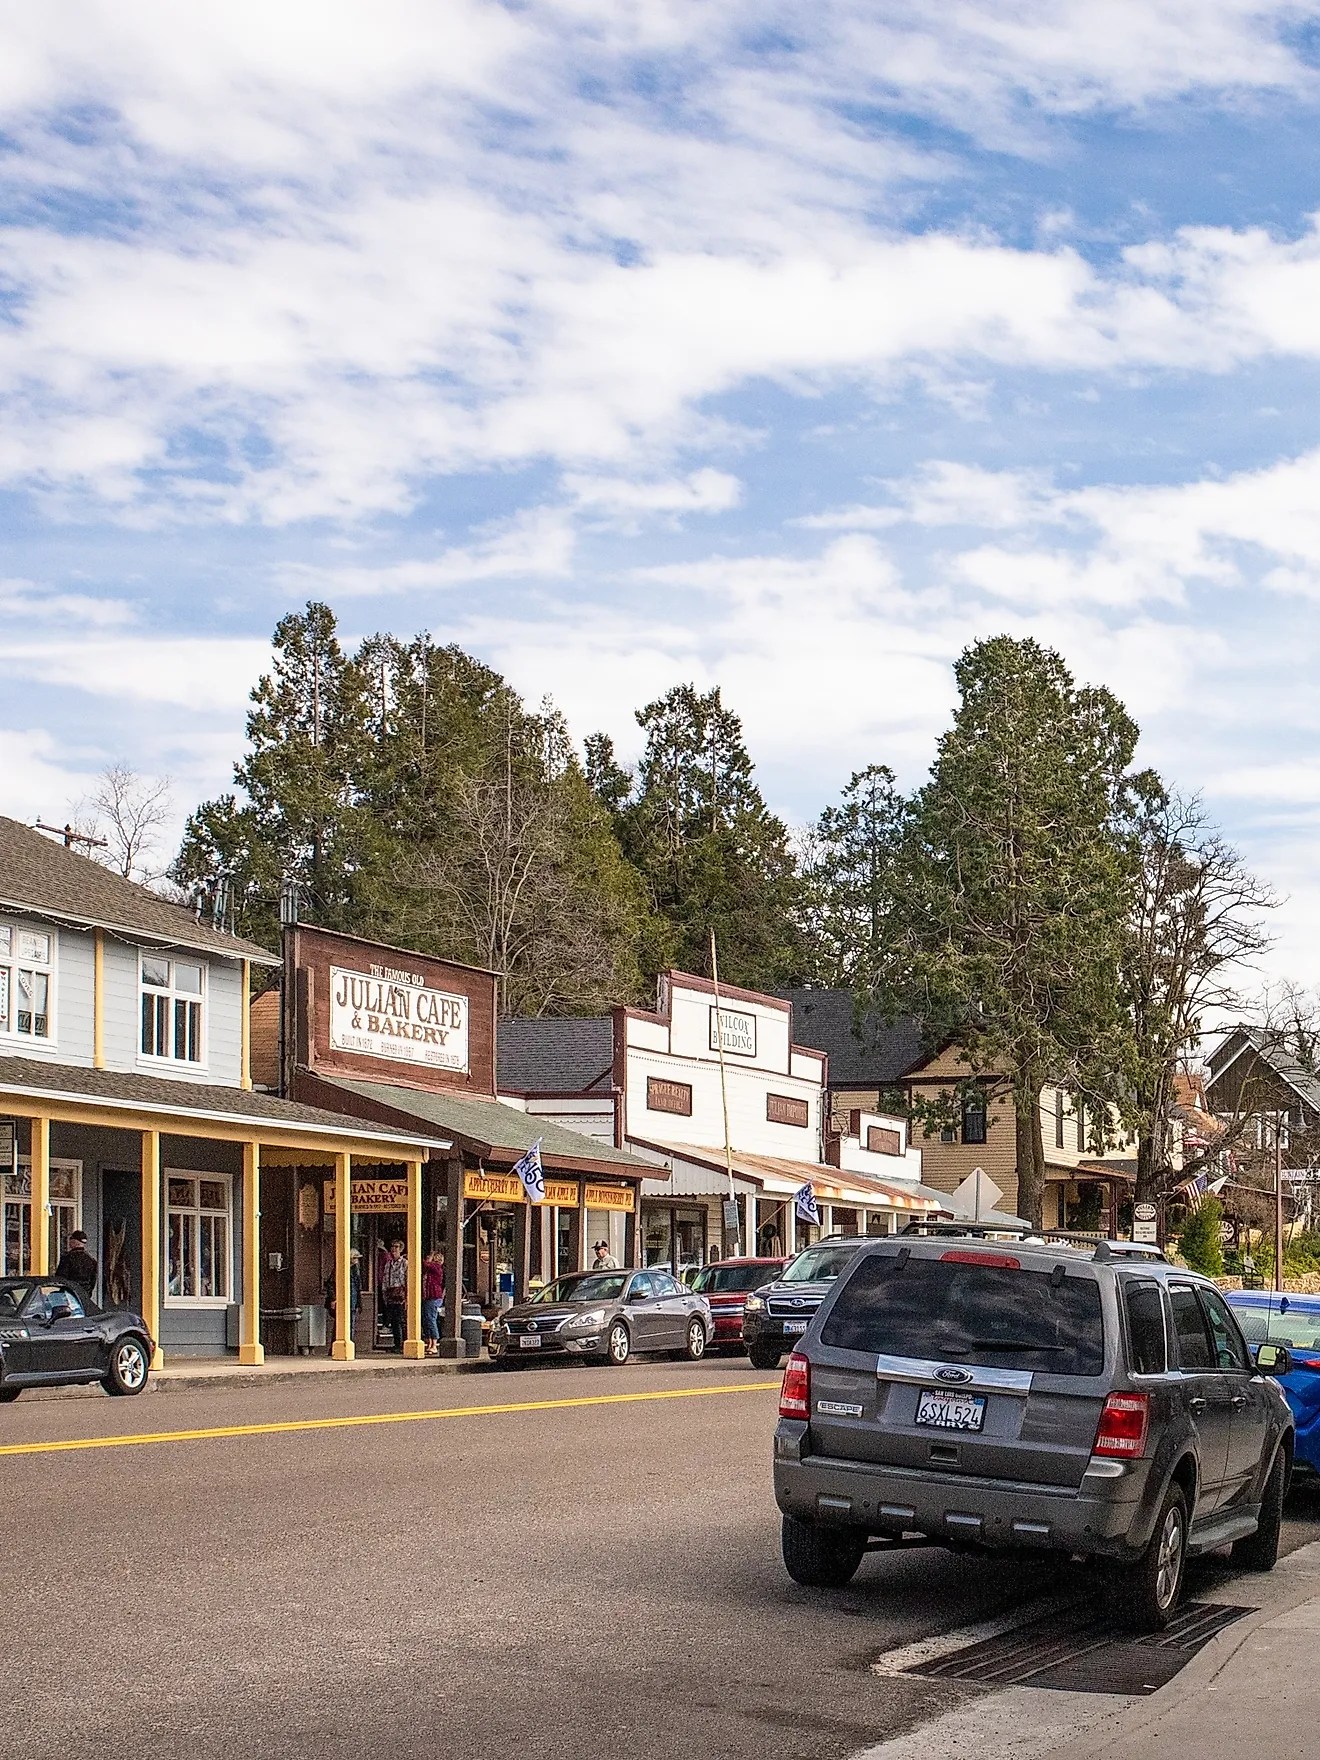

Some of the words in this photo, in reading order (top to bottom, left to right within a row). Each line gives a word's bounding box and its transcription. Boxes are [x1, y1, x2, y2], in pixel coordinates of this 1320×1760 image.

[370, 964, 383, 977] THE
[385, 966, 410, 984] FAMOUS
[412, 974, 424, 986] OLD
[336, 976, 410, 1020] JULIAN
[416, 993, 461, 1029] CAFE
[351, 1011, 362, 1029] &
[367, 1014, 449, 1046] BAKERY
[330, 1182, 376, 1200] JIAN
[469, 1176, 486, 1192] APPLE
[352, 1195, 396, 1204] BAKERY
[943, 1369, 961, 1379] Ford
[820, 1402, 860, 1412] ESCAPE
[920, 1402, 979, 1425] 6SXL524
